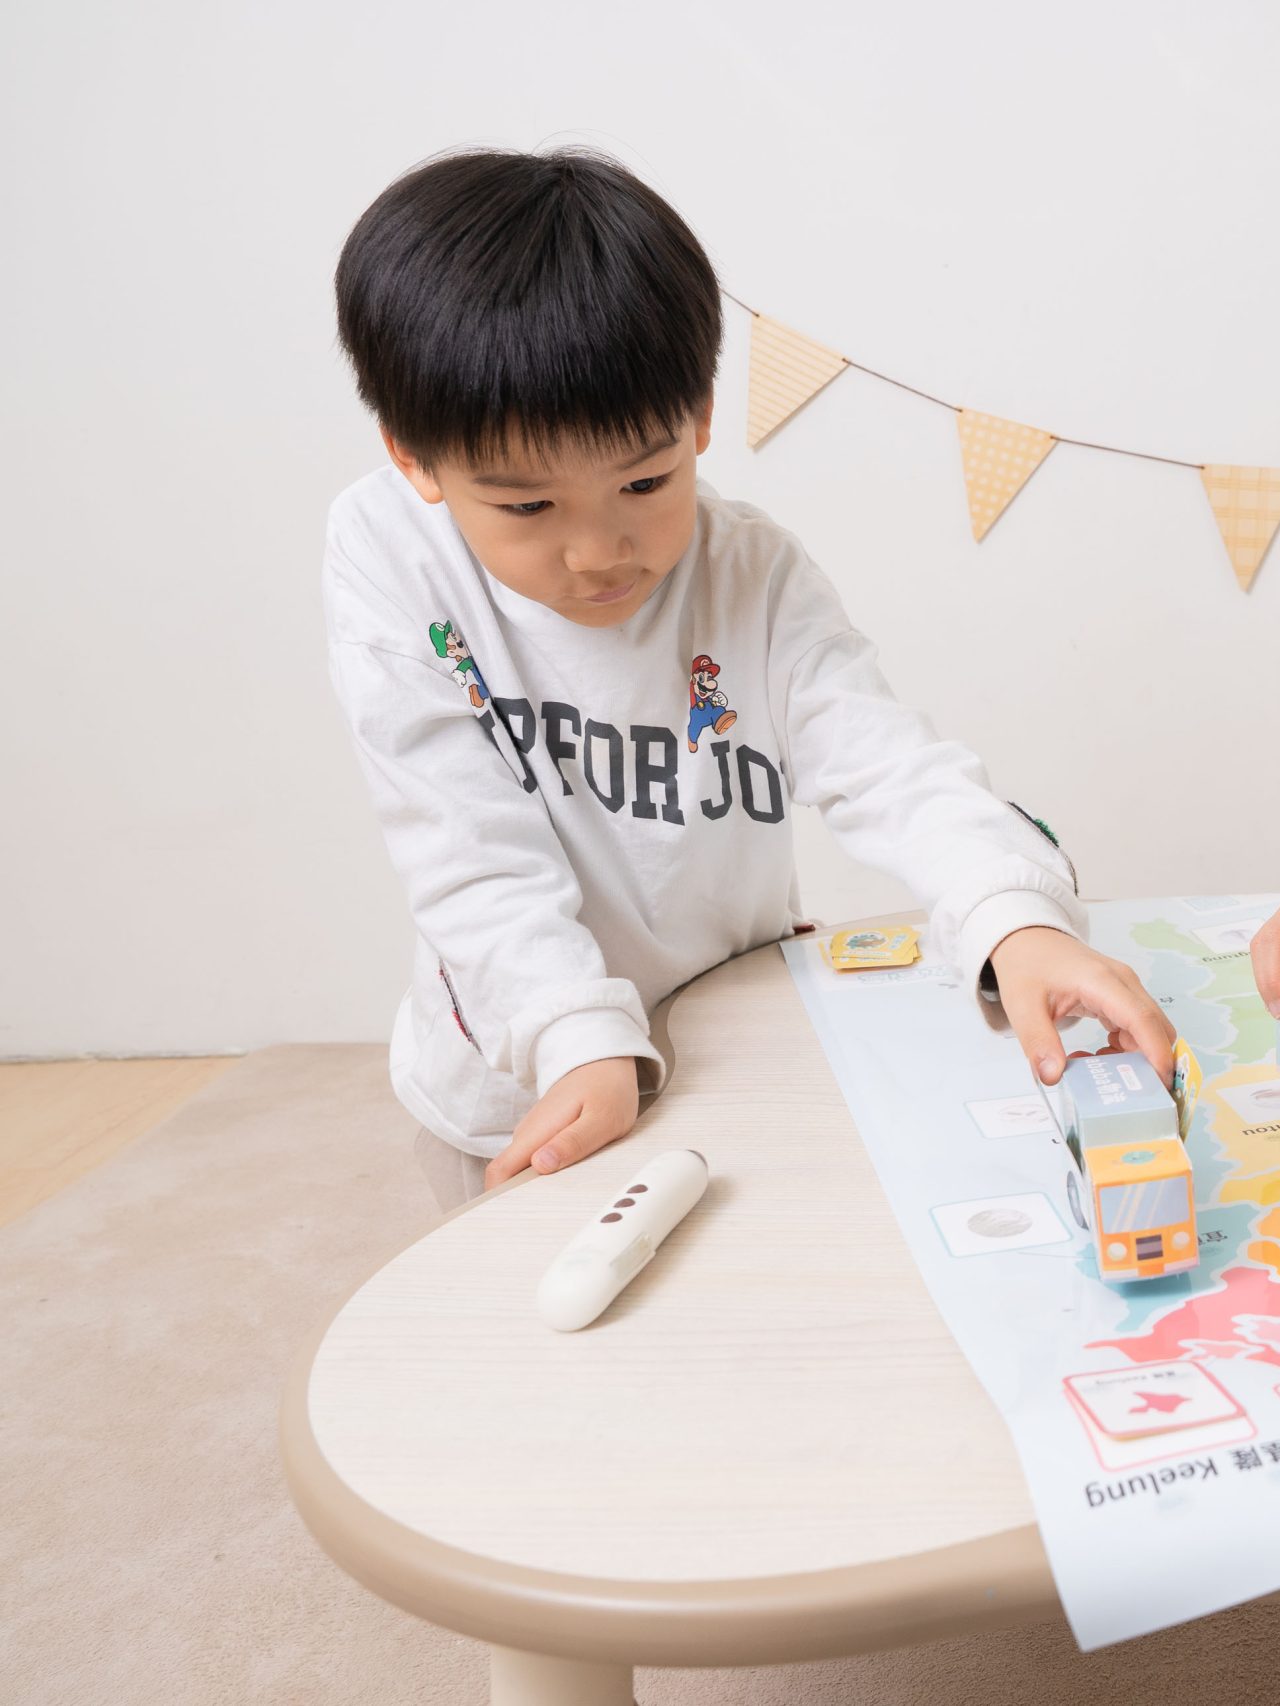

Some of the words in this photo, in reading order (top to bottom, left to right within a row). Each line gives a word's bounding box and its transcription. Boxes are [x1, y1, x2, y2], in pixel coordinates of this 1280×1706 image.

[700, 739, 785, 824] JO
[1198, 1229, 1228, 1244] 宜
[1083, 1456, 1219, 1508] Keelung
